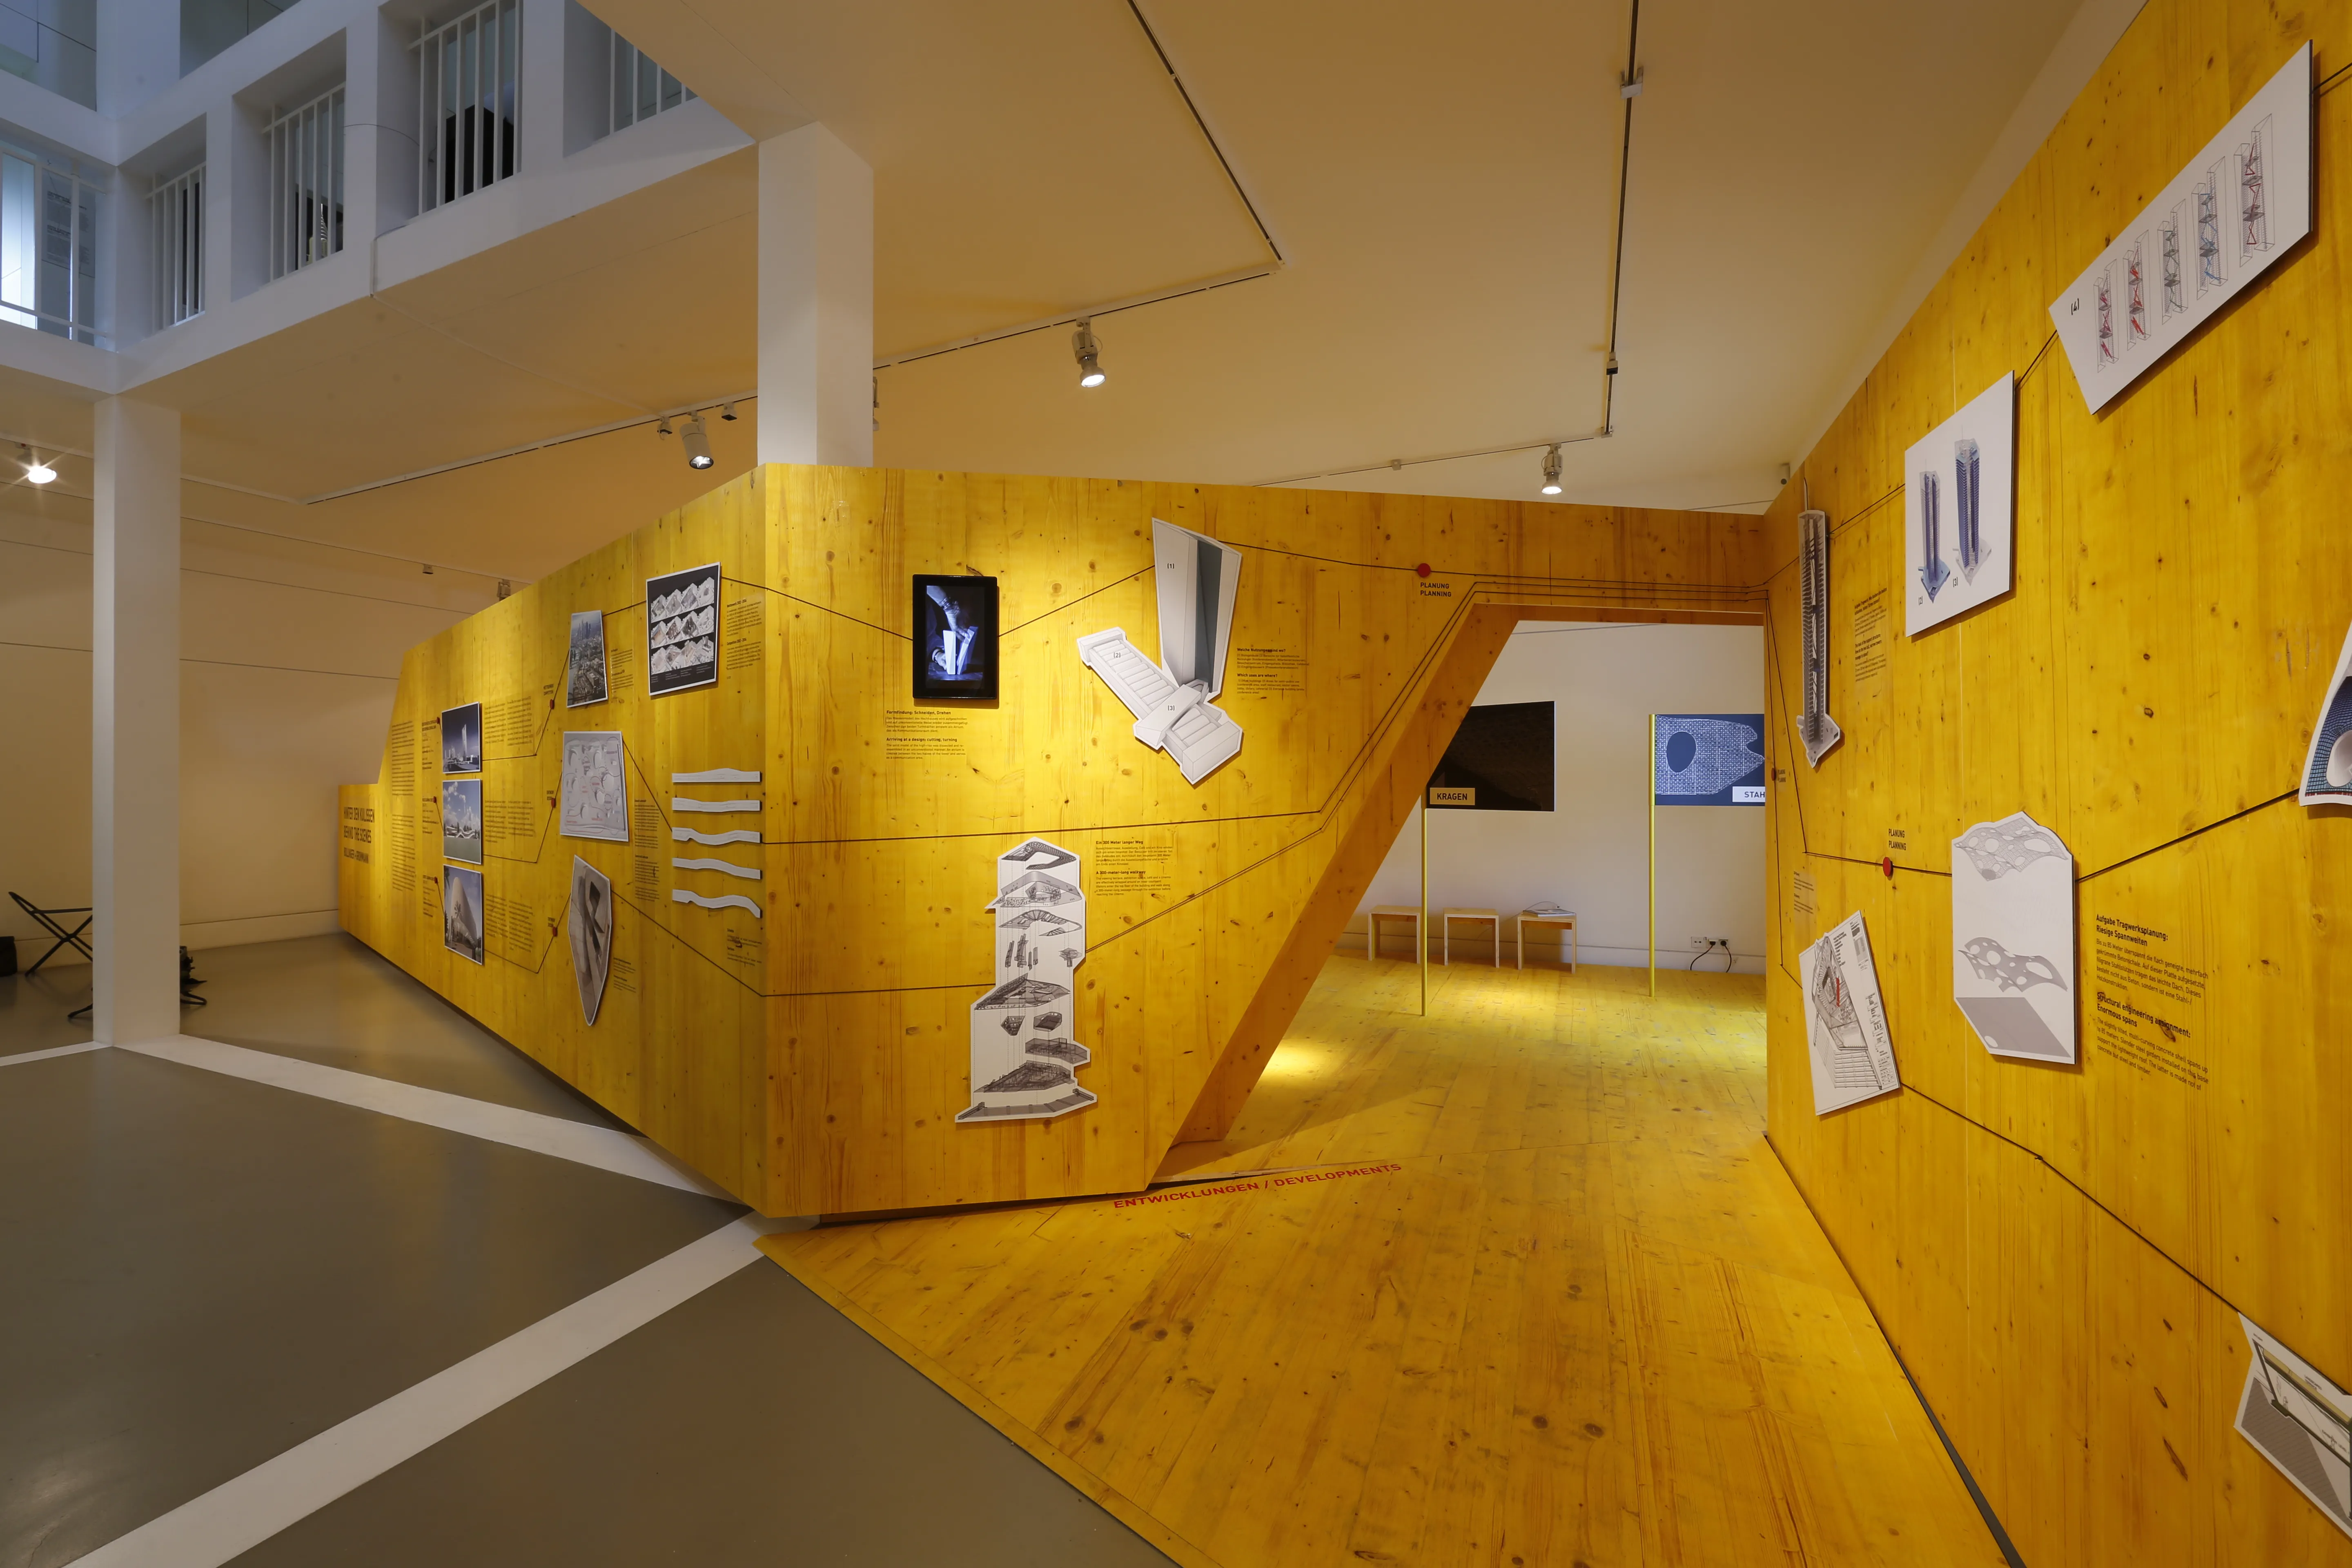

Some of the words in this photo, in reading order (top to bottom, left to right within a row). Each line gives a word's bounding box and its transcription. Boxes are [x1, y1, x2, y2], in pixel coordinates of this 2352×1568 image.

[1889, 829, 1905, 838] PLANUNG
[1889, 840, 1907, 851] PLANNING
[2096, 914, 2115, 925] Aufgabe
[2117, 919, 2168, 941] Tragwerksplanung:
[2096, 924, 2113, 937] Riesige
[2114, 930, 2147, 946] Spannweiten
[2096, 956, 2110, 966] grane
[2135, 970, 2147, 979] tragen
[2157, 977, 2171, 987] leichte
[2185, 987, 2201, 998] Dieses
[2117, 954, 2140, 967] Betonschale.
[2150, 965, 2163, 973] dieser
[2164, 969, 2176, 979] Platte
[2178, 976, 2205, 990] aufgesetzte,
[2154, 956, 2163, 964] flach
[2165, 961, 2184, 972] geneigte,
[2185, 968, 2208, 979] mehrfach
[2127, 976, 2140, 987] Beton,
[2141, 982, 2158, 992] sondern
[2097, 992, 2121, 1009] Structural
[2122, 1004, 2153, 1024] engineering
[2154, 1018, 2190, 1038] assignment:
[2097, 1003, 2121, 1020] Enormous
[2122, 1016, 2137, 1027] spans
[2097, 1036, 2110, 1045] support
[2157, 1064, 2169, 1074] latter
[2174, 1074, 2187, 1084] made
[2097, 1045, 2111, 1056] concrete
[2119, 1056, 2128, 1064] steel
[2137, 1064, 2151, 1076] timber.
[2120, 1037, 2134, 1047] Slender
[2136, 1045, 2145, 1054] steel
[2146, 1050, 2160, 1060] girders
[2161, 1058, 2180, 1070] installed
[2187, 1069, 2196, 1079] this
[2197, 1073, 2208, 1083] base
[2156, 1045, 2174, 1057] concrete
[2175, 1053, 2186, 1063] shell
[2187, 1060, 2201, 1069] spans
[1114, 1182, 1260, 1208] ENTWICKLUNGEN
[1265, 1180, 1268, 1189] /
[1274, 1164, 1402, 1186] DEVELOPMENTS
